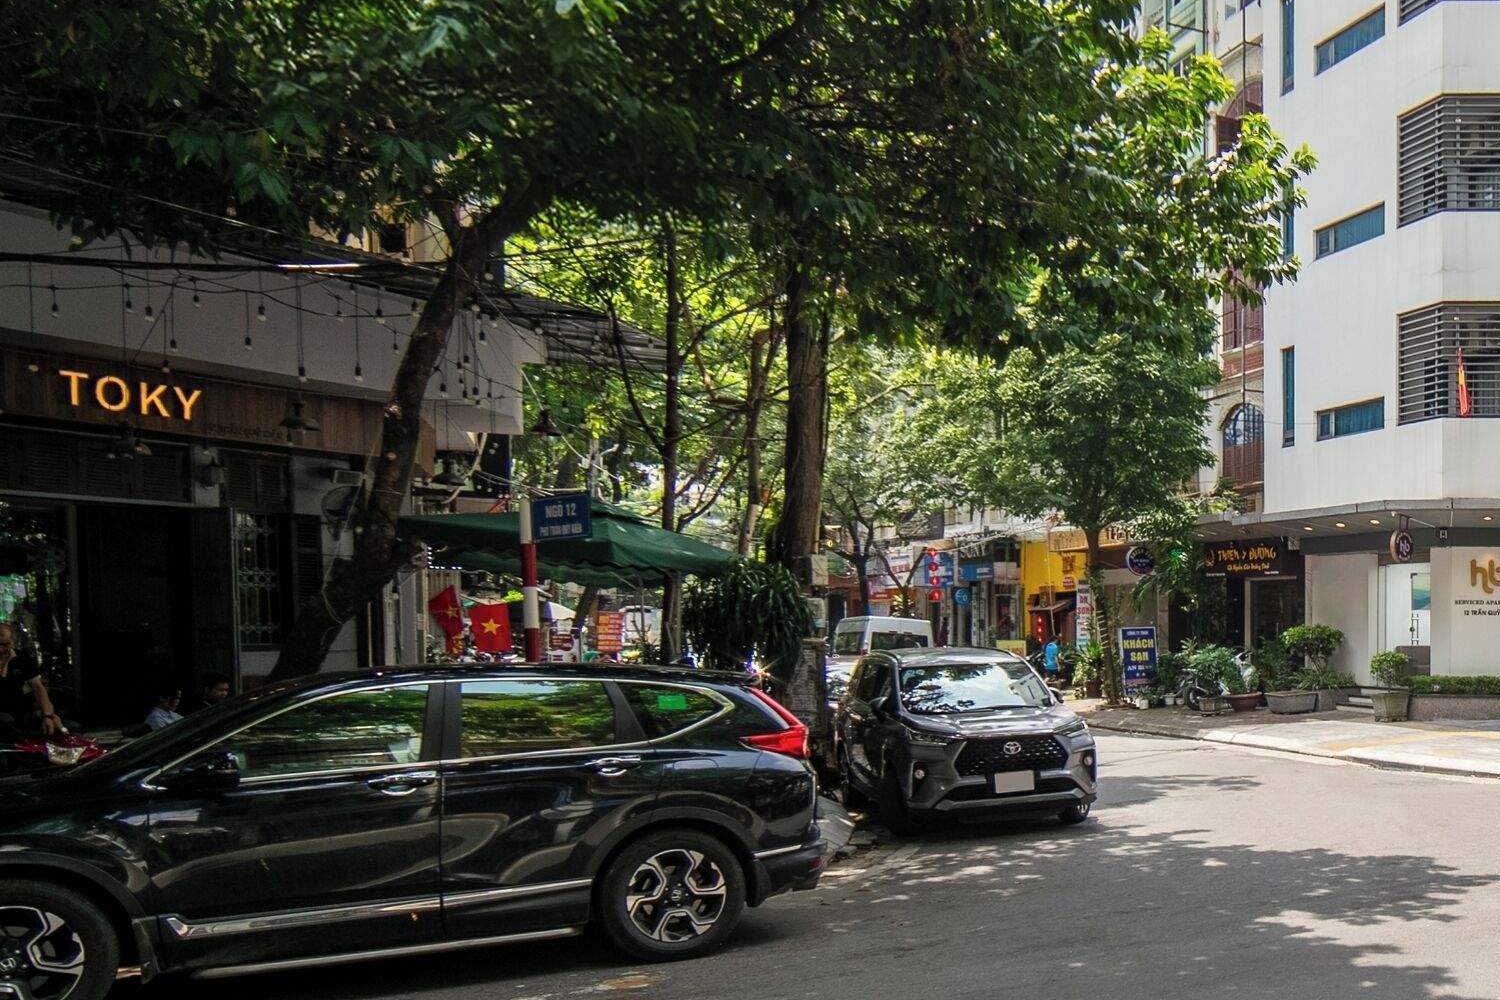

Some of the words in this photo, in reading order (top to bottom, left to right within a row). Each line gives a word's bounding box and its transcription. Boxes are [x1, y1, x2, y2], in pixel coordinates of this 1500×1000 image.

[58, 369, 202, 420] TOKY
[545, 501, 564, 519] NGÕ
[566, 502, 577, 516] 12
[1123, 638, 1153, 649] KHÁCH
[1130, 651, 1149, 663] SẠN
